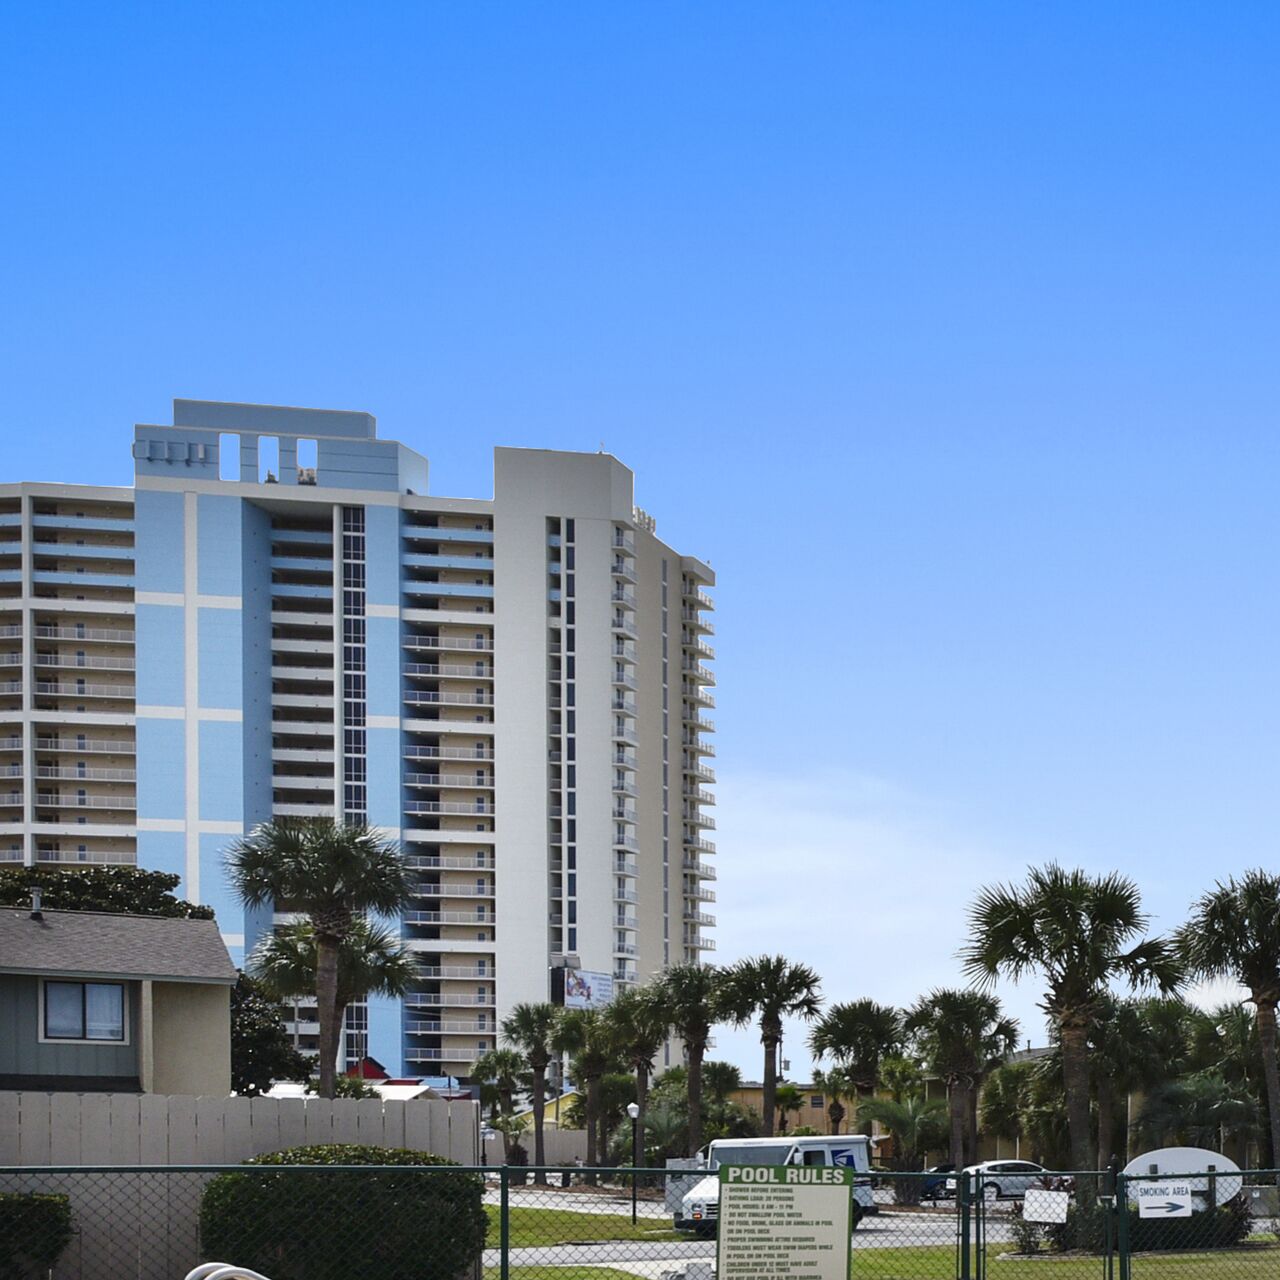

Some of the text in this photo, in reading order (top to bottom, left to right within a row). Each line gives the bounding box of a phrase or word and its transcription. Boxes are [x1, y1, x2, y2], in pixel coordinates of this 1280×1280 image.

[728, 1167, 845, 1184] POOL RULES
[1140, 1186, 1189, 1196] SMOKING AREA
